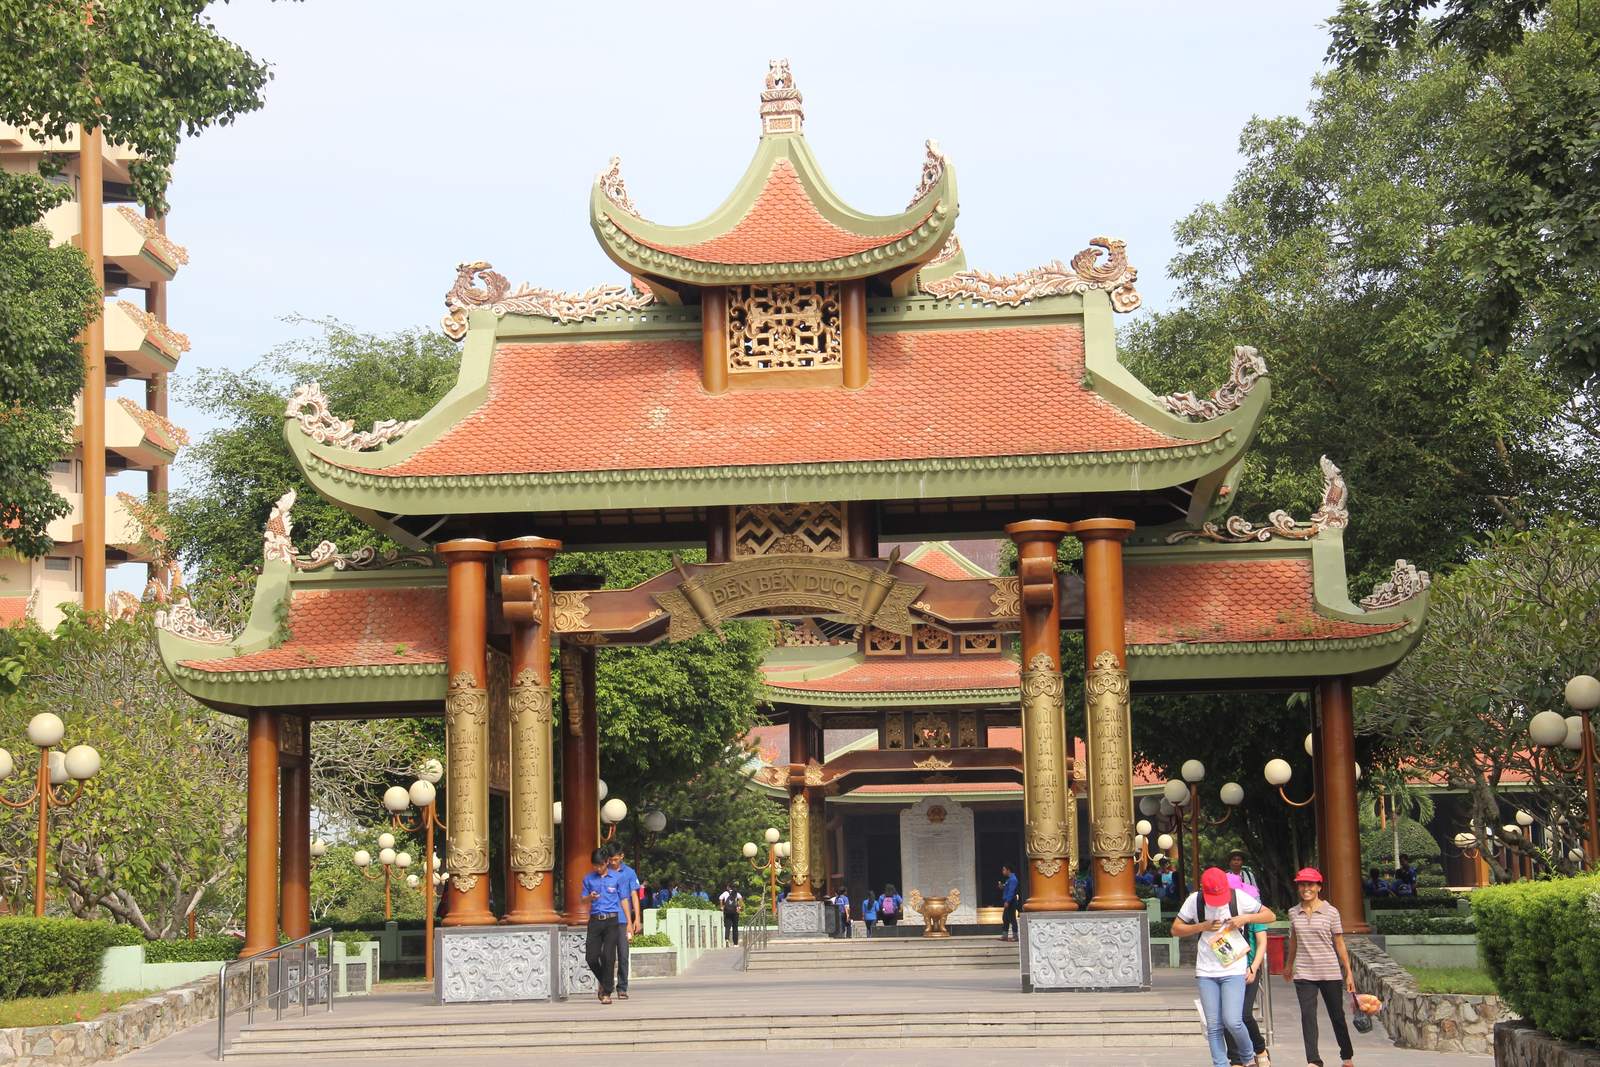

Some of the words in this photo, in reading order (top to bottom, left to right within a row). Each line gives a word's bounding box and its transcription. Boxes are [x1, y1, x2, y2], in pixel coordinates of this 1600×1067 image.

[757, 570, 800, 593] BẾN
[1096, 705, 1122, 722] MÊNH
[1097, 723, 1122, 738] MÔNG
[1033, 774, 1058, 787] DANH
